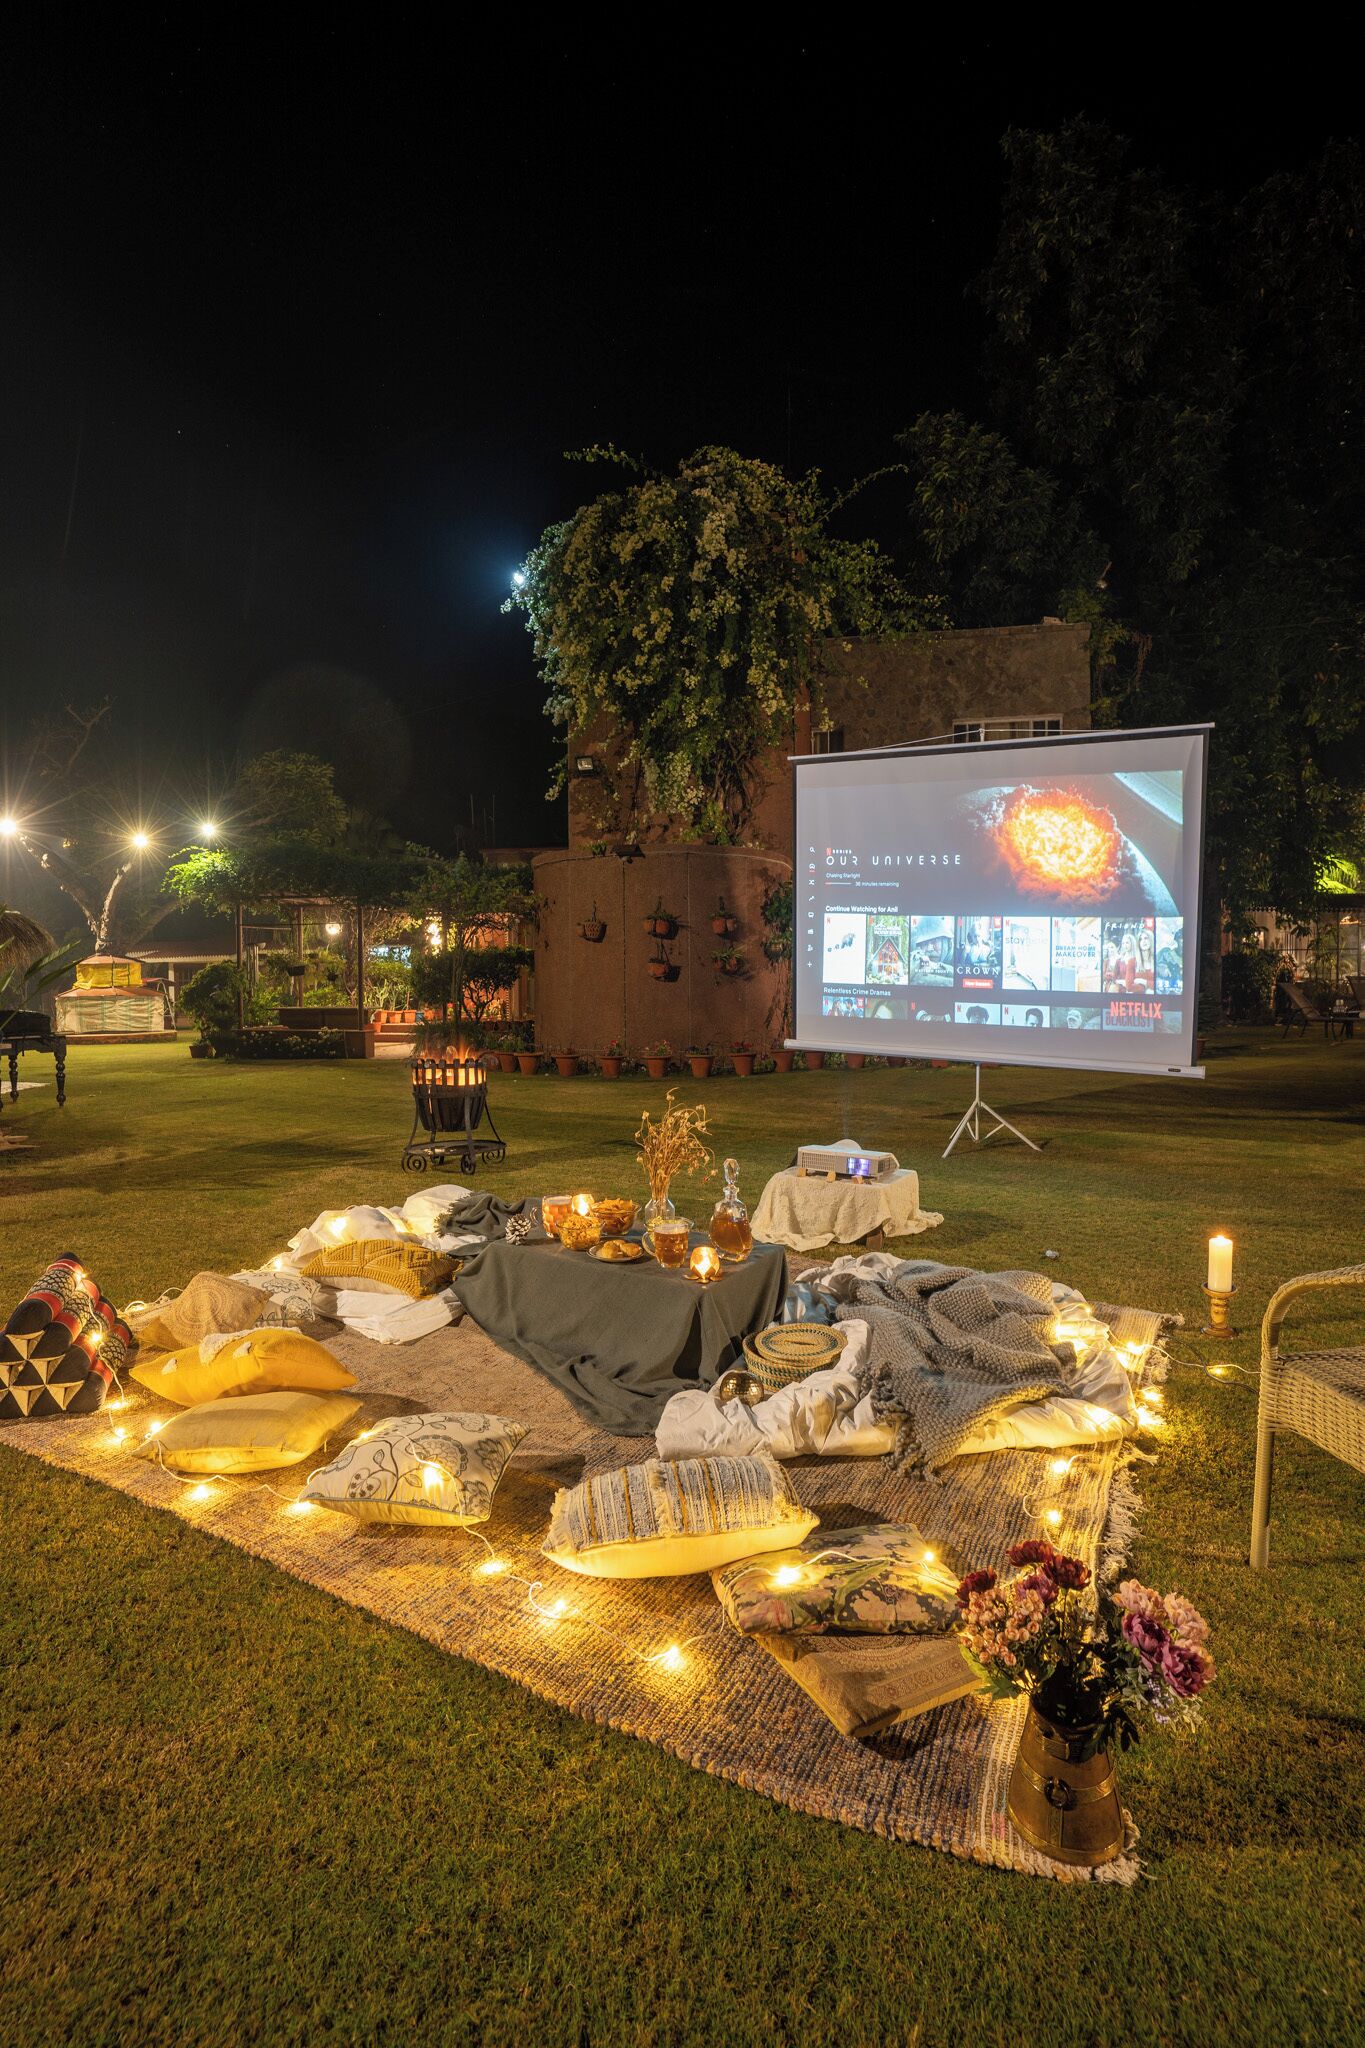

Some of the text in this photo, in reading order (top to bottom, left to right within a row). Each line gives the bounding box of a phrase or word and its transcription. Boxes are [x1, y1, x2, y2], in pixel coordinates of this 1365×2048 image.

[826, 854, 961, 866] OUR UNIVERSE
[851, 905, 877, 913] Watching
[956, 966, 998, 975] CROWN
[1110, 1001, 1162, 1019] NETFLIX
